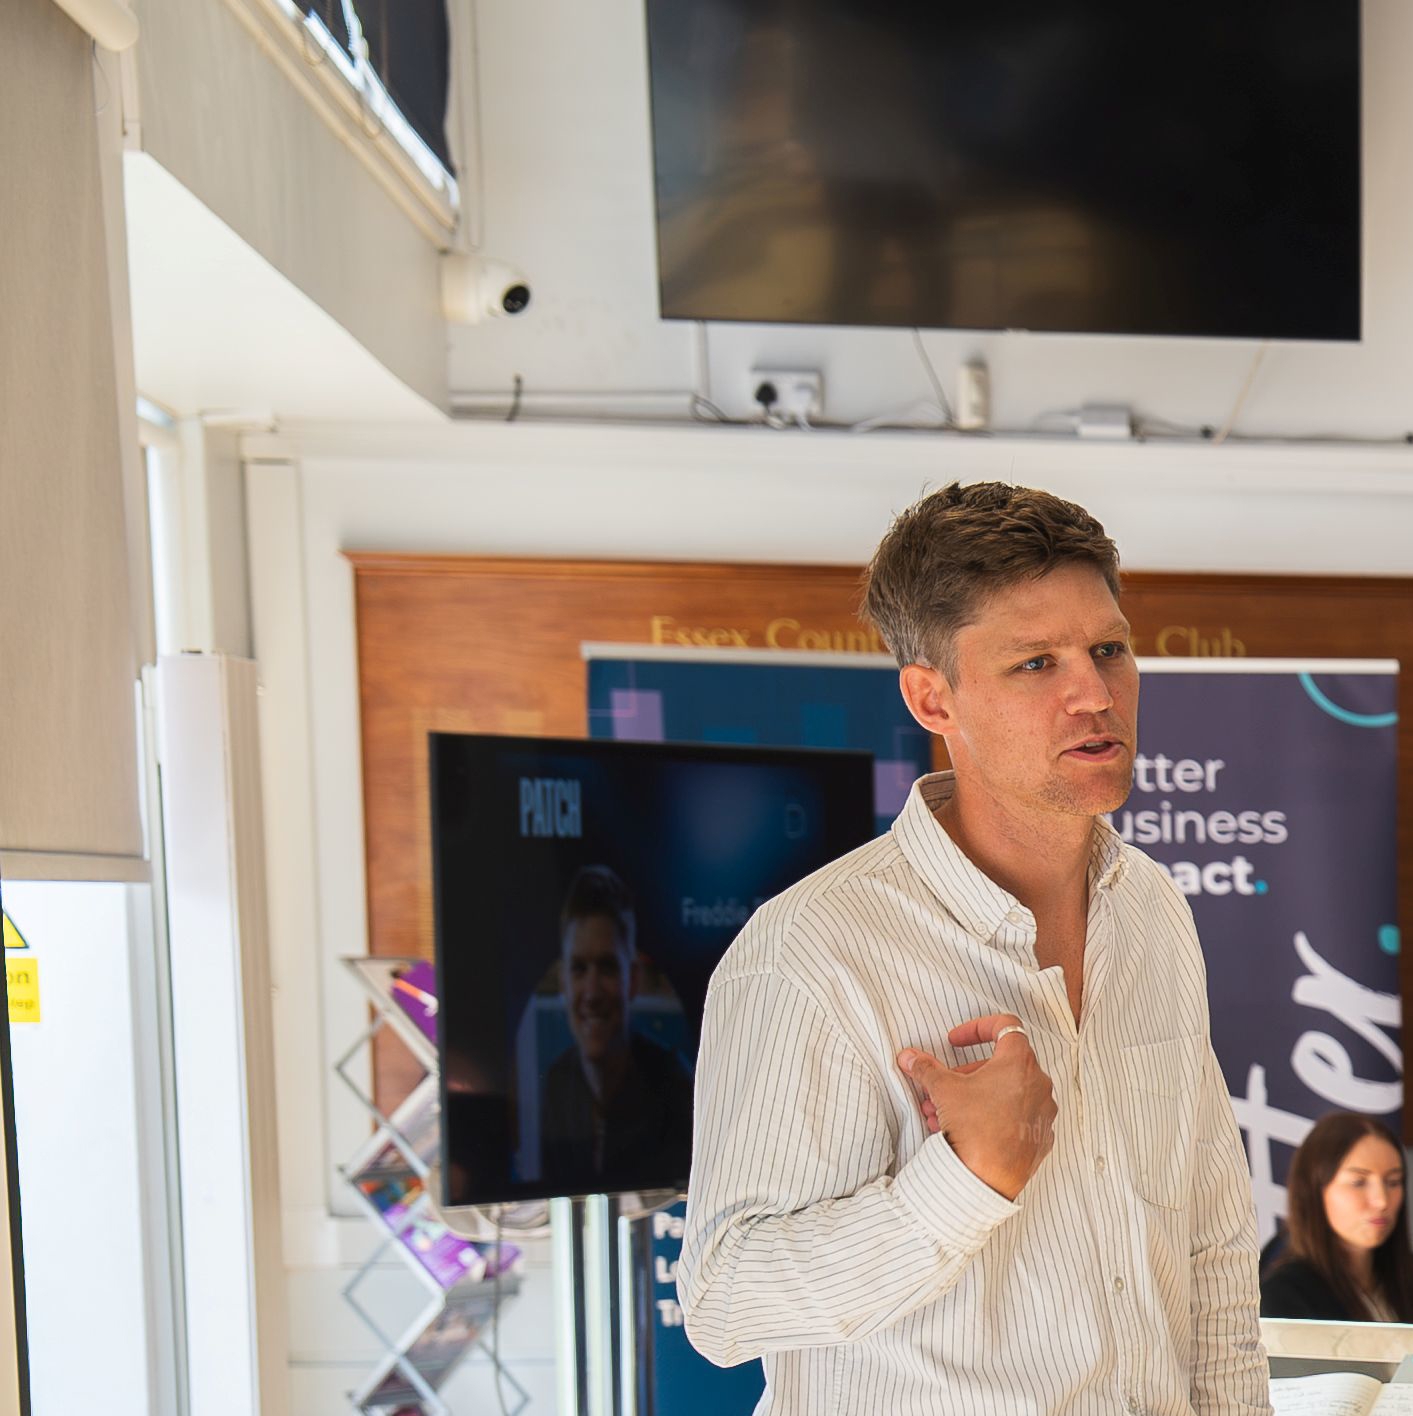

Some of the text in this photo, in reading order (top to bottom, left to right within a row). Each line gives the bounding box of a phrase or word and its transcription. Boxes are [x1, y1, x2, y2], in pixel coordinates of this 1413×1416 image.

[766, 617, 880, 653] Count
[1133, 753, 1226, 793] tter
[519, 777, 582, 838] PATCH
[1104, 800, 1288, 845] usiness
[1157, 855, 1269, 896] act.
